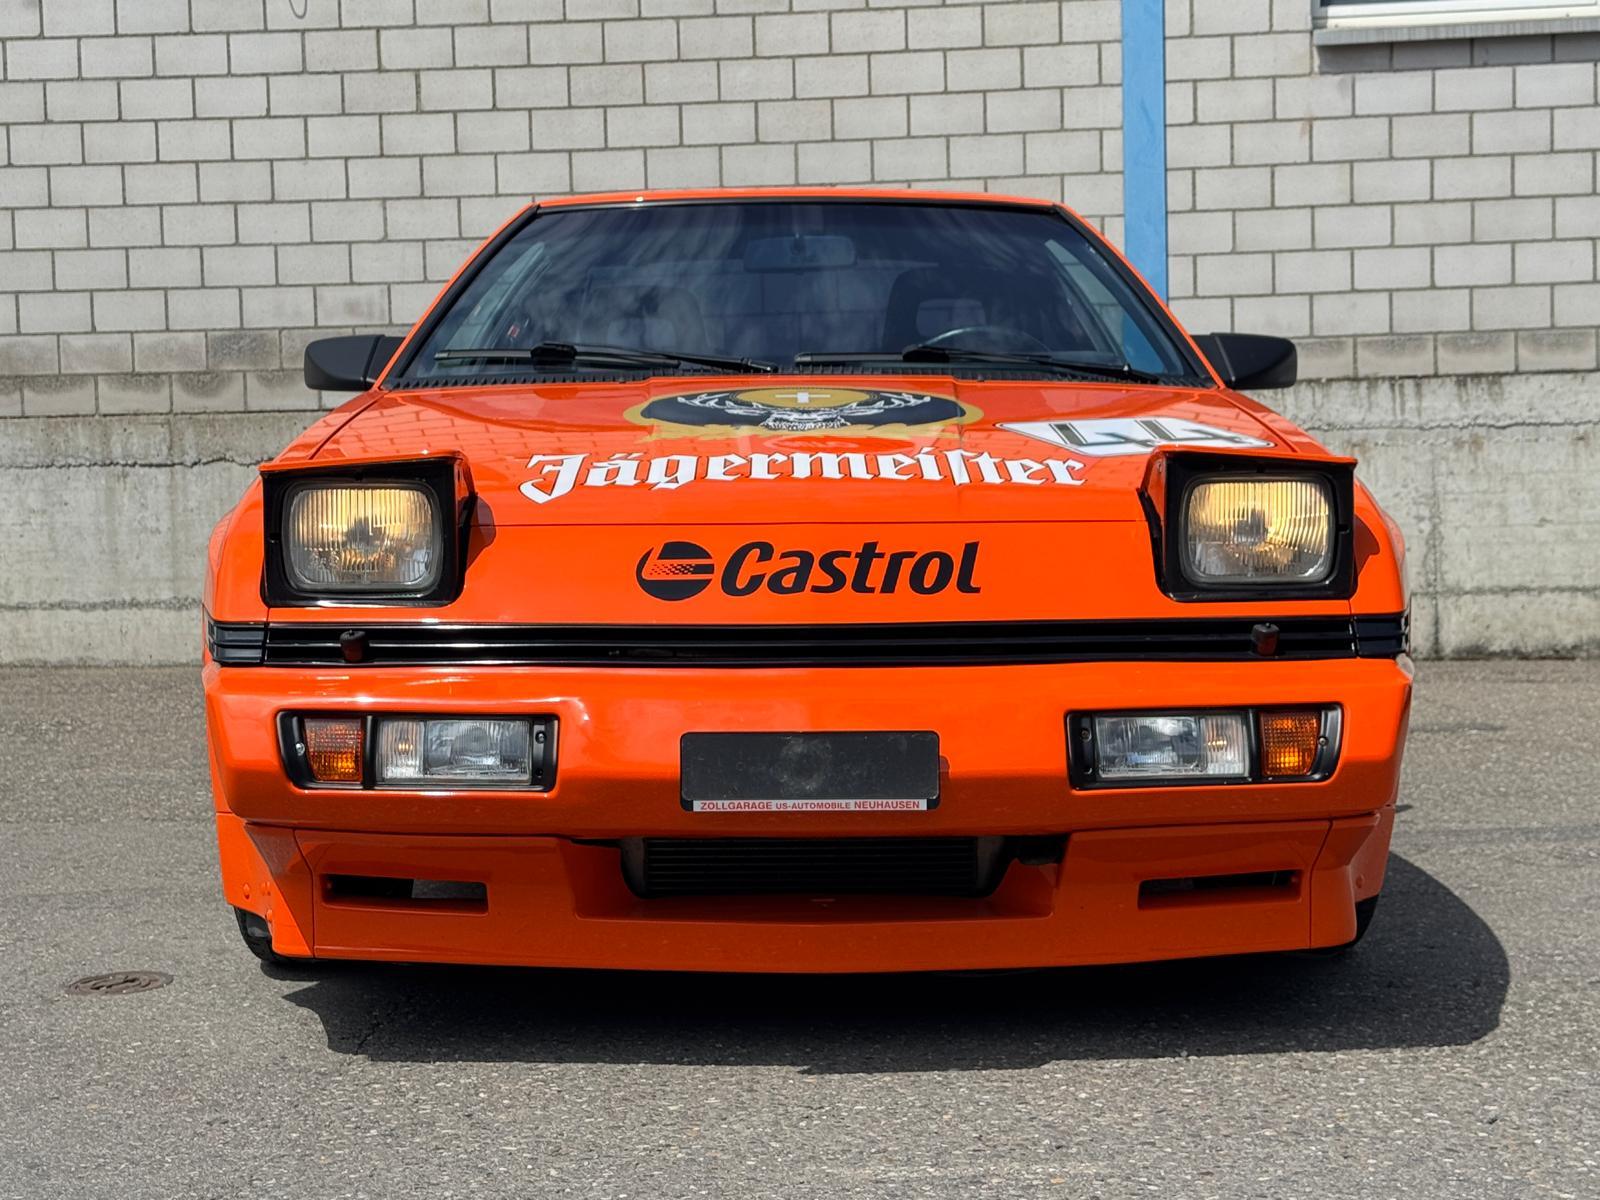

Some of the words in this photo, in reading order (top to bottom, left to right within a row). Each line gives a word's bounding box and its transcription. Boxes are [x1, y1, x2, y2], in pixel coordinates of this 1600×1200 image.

[722, 541, 981, 595] Castrol
[701, 800, 773, 811] ZOLLGARAGE
[775, 802, 852, 810] US-AUTOMOBILE
[854, 799, 920, 810] NEUHAUSEN
